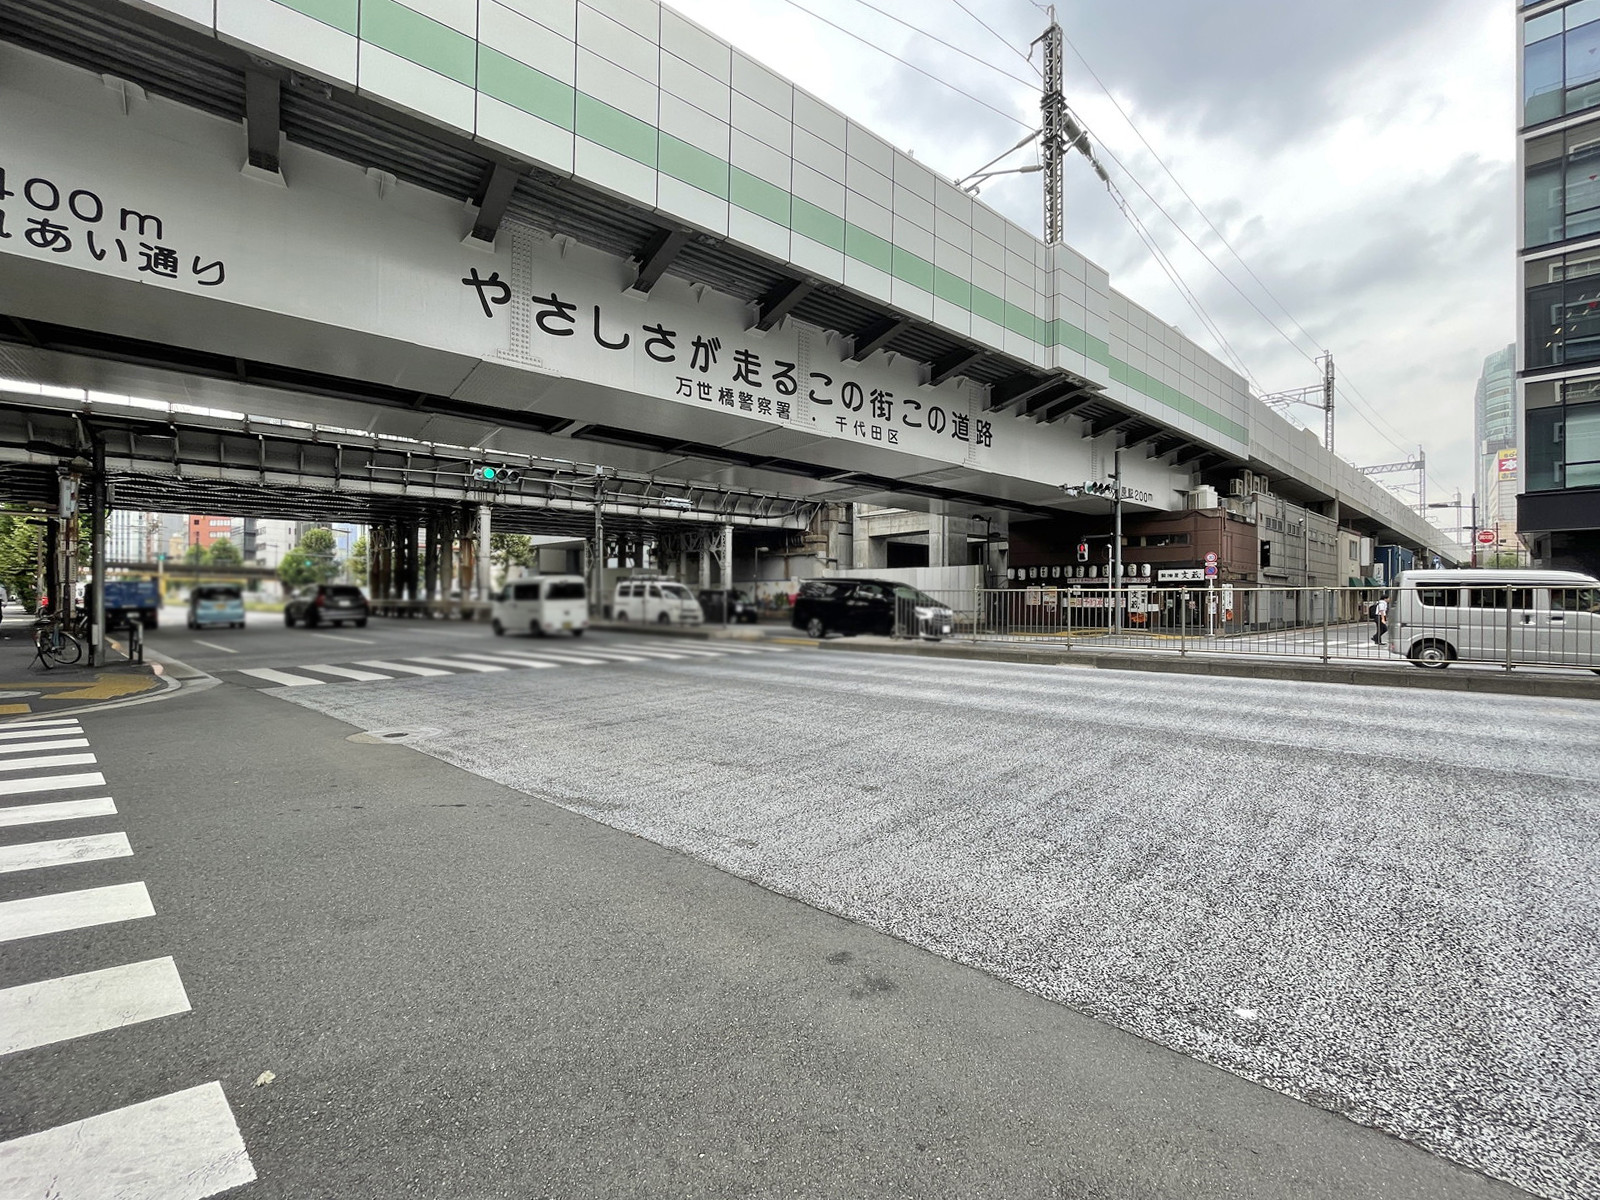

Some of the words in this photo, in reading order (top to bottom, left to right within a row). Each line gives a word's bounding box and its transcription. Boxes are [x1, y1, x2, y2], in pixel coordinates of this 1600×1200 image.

[462, 267, 994, 448] やさしさが走るこの街この道路
